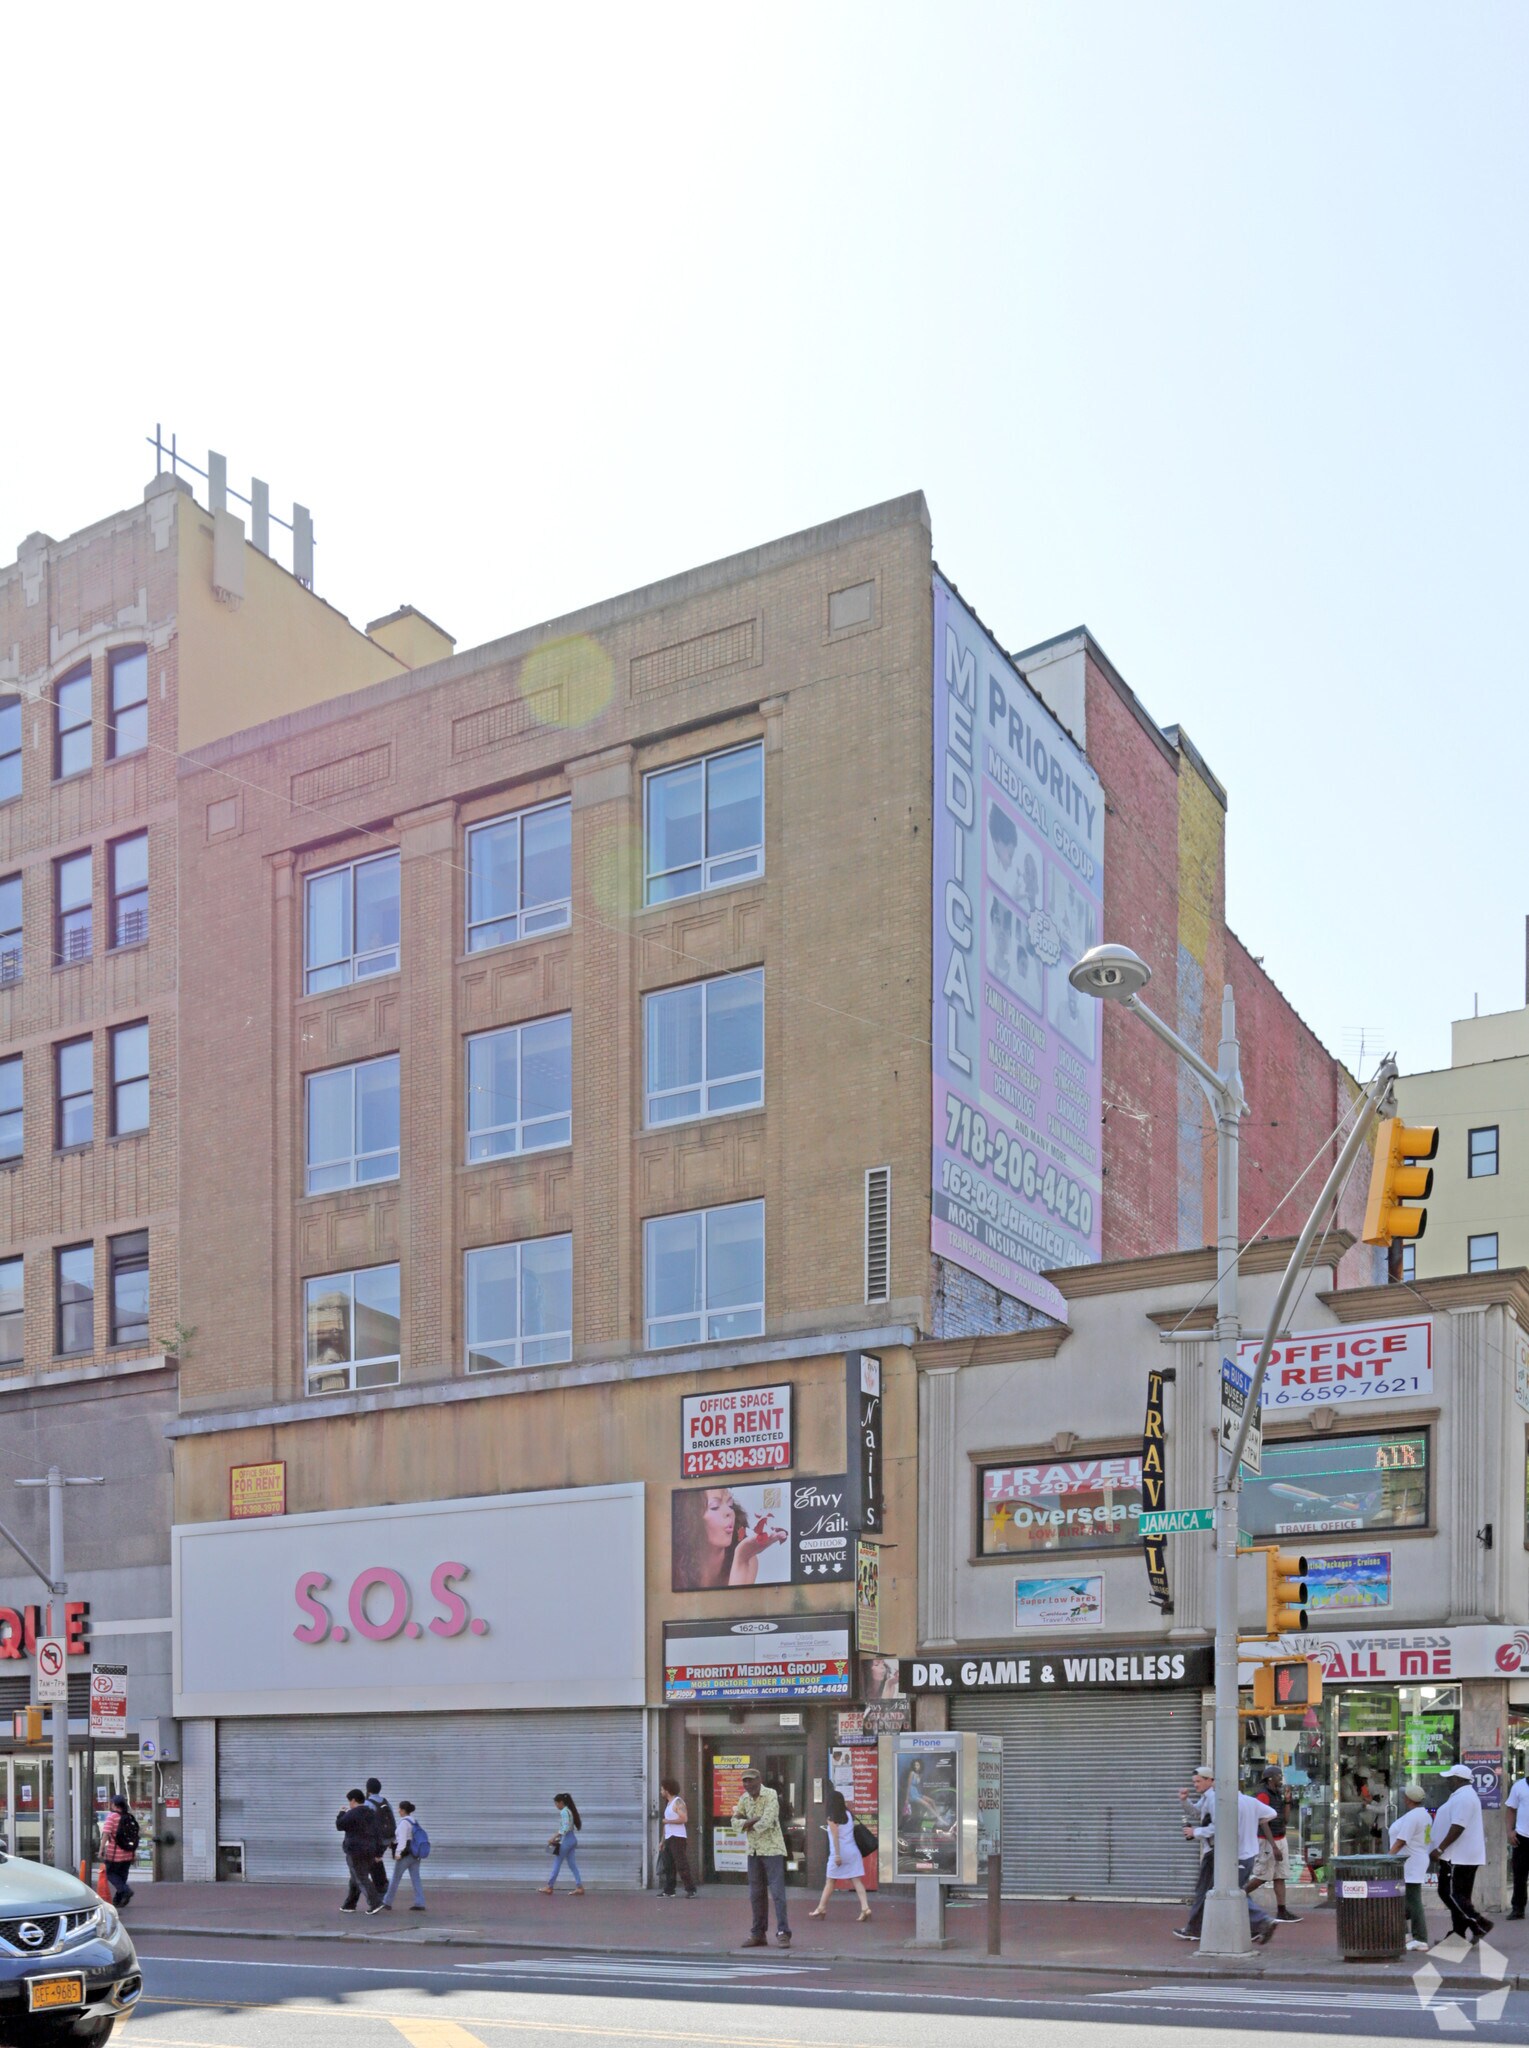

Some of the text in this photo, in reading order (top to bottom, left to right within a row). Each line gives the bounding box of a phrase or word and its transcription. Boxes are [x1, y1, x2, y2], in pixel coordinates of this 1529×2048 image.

[988, 672, 1097, 840] PRIORITY
[987, 744, 1095, 883] MEDICAL GROUP
[944, 622, 975, 1079] MEDICAL
[1031, 933, 1060, 958] Floor
[993, 1070, 1036, 1122] DERMATOLOGY
[1015, 1119, 1029, 1138] AND
[1030, 1129, 1050, 1153] MANY
[945, 1091, 1093, 1240] 718-206-4420
[942, 1159, 999, 1222] 162-04
[1001, 1199, 1064, 1263] Jamaica
[948, 1201, 979, 1237] MOST
[948, 1230, 1012, 1281] TRANSPORTATION
[1253, 1334, 1407, 1367] OFFICE
[1231, 1367, 1244, 1387] BUS
[1281, 1357, 1392, 1387] RENT
[700, 1391, 775, 1413] OFFICE SPACE
[1224, 1382, 1244, 1406] BUSES
[1262, 1376, 1419, 1405] 16-659-7621
[690, 1407, 784, 1439] FOR RENT
[692, 1431, 784, 1449] BROKERS PROTECTED
[687, 1445, 784, 1473] 212-398-3970
[860, 1398, 880, 1526] Nails
[1374, 1444, 1417, 1468] AIR
[234, 1475, 280, 1492] FOR RENT
[984, 1457, 1143, 1489] TRAVEL
[1142, 1374, 1165, 1575] TRAVL
[793, 1486, 843, 1509] Envy
[989, 1484, 1032, 1499] 718
[1039, 1480, 1084, 1496] 297
[1013, 1502, 1143, 1528] Overseas
[1141, 1511, 1200, 1532] JAMAICA
[1279, 1520, 1357, 1533] TRAVEL OFFICE
[803, 1538, 843, 1549] 2ND FLOOR
[800, 1550, 847, 1563] ENTRANCE
[1357, 1558, 1381, 1567] Cruises
[292, 1561, 490, 1645] S.O.S.
[1020, 1595, 1097, 1606] Super Low Fares
[739, 1623, 770, 1632] 162-04
[686, 1662, 827, 1679] PRIORITY MEDICAL GROUP
[912, 1654, 1185, 1687] DR. GAME & WIRELESS
[1400, 1649, 1451, 1676] ME
[713, 1679, 749, 1687] DOCTORS
[751, 1678, 777, 1686] UNDER
[780, 1677, 796, 1685] ONE
[799, 1676, 821, 1684] ROOF
[794, 1684, 848, 1695] 718-206-4420
[847, 1713, 864, 1721] SPAC
[912, 1738, 941, 1747] Phone
[720, 1756, 742, 1764] Priority
[978, 1799, 999, 1812] QUEENS
[56, 1983, 78, 2000] 9685
